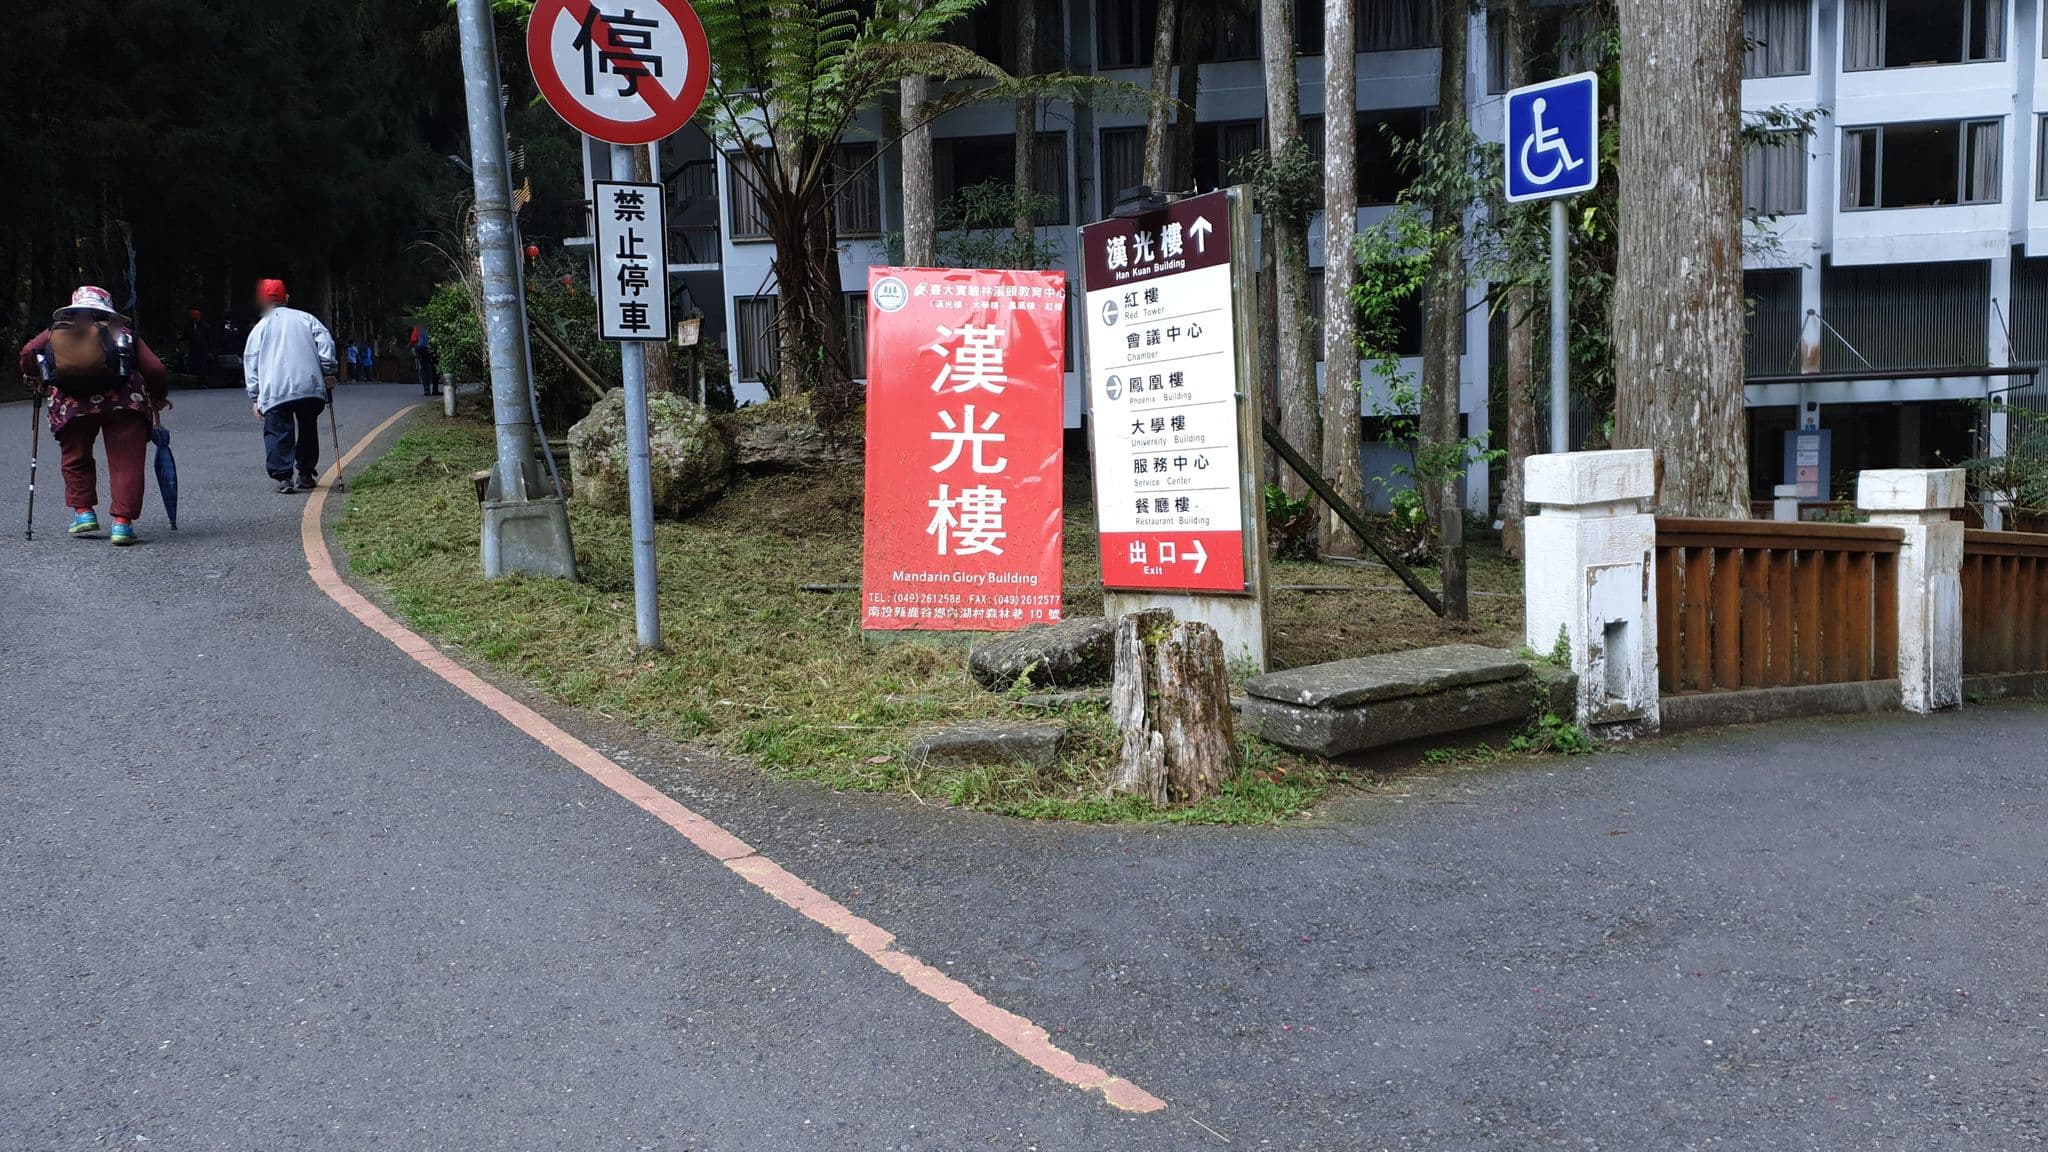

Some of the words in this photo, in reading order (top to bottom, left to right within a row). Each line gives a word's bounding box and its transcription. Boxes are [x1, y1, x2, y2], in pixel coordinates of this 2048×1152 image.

[572, 3, 663, 97] 停
[1106, 221, 1184, 271] 漢光樓
[613, 188, 651, 334] 禁止停車
[1116, 271, 1130, 280] Han
[1132, 265, 1151, 278] Kuan
[1154, 259, 1186, 272] Building
[1124, 287, 1159, 308] 紅樓
[1125, 311, 1138, 320] Red
[1143, 306, 1165, 317] Tower
[1126, 322, 1203, 350] 會議中心
[1127, 351, 1158, 362] Chamber
[1129, 371, 1185, 393] 鳳凰樓
[1129, 396, 1155, 405] Phoenix
[1163, 391, 1192, 402] Building
[1131, 415, 1186, 435] 大學樓
[926, 323, 1008, 556] 漢光樓
[1131, 437, 1167, 447] University
[1174, 434, 1205, 444] Building
[1134, 454, 1209, 474] 服務中心
[1134, 478, 1160, 487] Service
[1167, 476, 1191, 486] Center
[1135, 496, 1190, 514] 餐廳樓
[1135, 517, 1174, 526] Restaurant
[1179, 516, 1210, 526] Building
[1129, 540, 1176, 564] 出口
[893, 571, 950, 583] Mandarin
[953, 571, 985, 586] Glory
[988, 572, 1038, 587] Building
[1143, 566, 1163, 575] Exit
